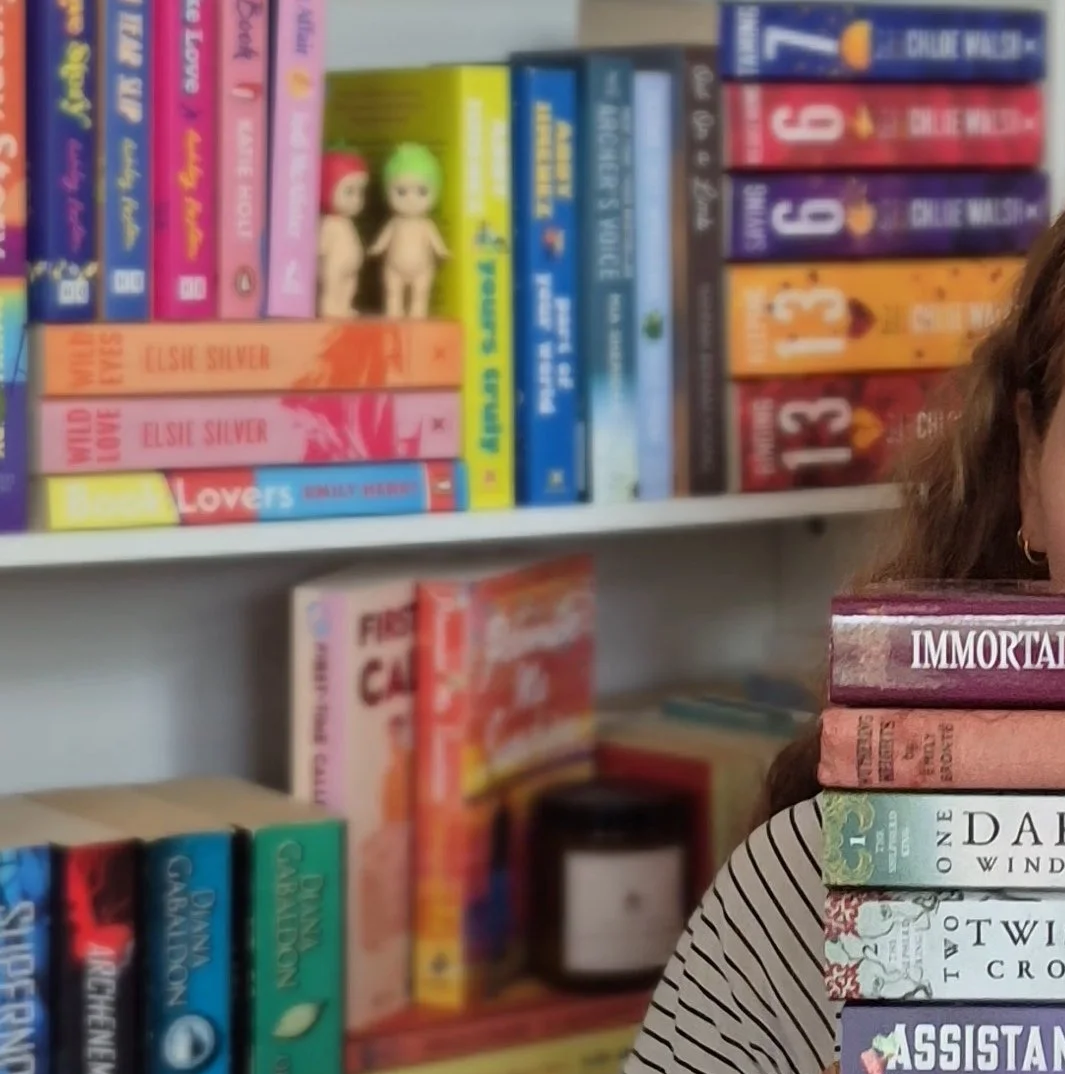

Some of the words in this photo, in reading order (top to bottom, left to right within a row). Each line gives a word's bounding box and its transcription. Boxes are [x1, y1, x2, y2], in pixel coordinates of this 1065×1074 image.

[762, 26, 839, 61] 7
[769, 104, 845, 141] 6
[770, 199, 845, 236] 6
[479, 258, 501, 355] yours
[773, 288, 846, 357] 13
[143, 345, 196, 374] ELSIE
[206, 344, 270, 371] SILVER
[66, 409, 93, 464] WILD
[96, 408, 121, 464] LOVE
[142, 421, 195, 448] ELSIE
[204, 418, 267, 445] SILVER
[778, 397, 852, 470] 13
[177, 478, 295, 513] Lovers
[849, 835, 866, 847] 1
[936, 809, 952, 875] ONE
[165, 855, 193, 1008] GABALDON
[191, 888, 216, 969] DIANA
[274, 840, 301, 989] GABALDON
[297, 873, 323, 952] DIANA
[862, 944, 878, 957] 2
[943, 915, 960, 983] TWO
